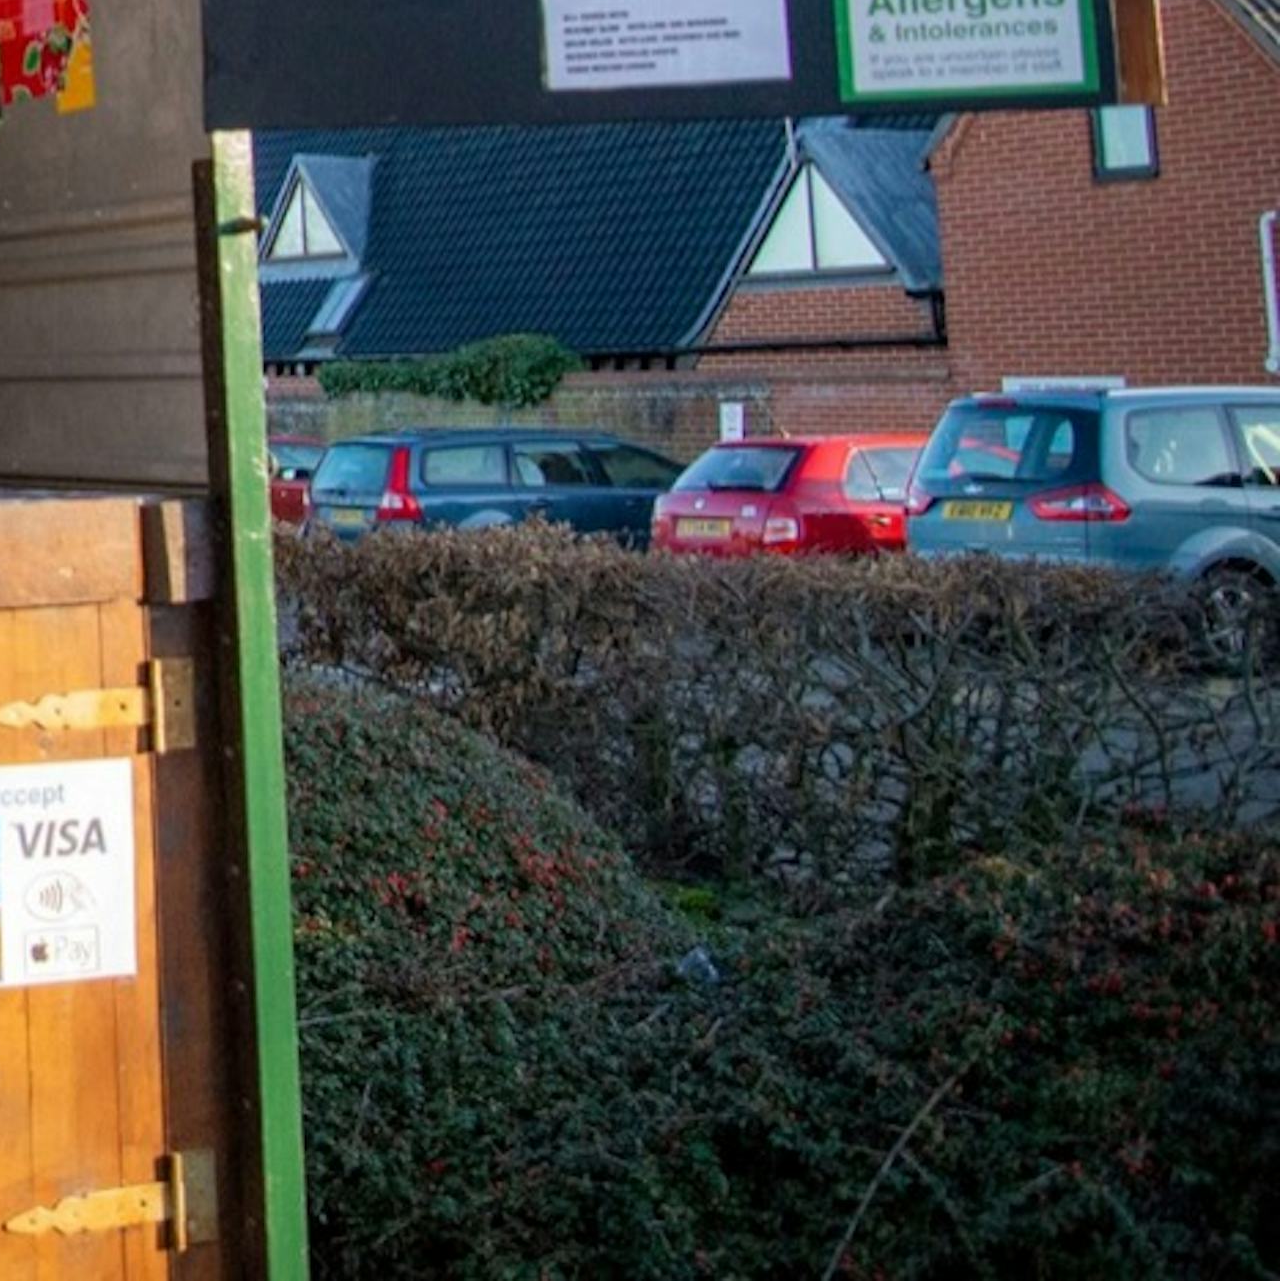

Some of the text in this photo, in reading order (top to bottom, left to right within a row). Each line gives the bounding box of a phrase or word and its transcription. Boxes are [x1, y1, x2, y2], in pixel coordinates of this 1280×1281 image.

[868, 18, 1059, 44] & Intolerances
[12, 816, 108, 859] VISA
